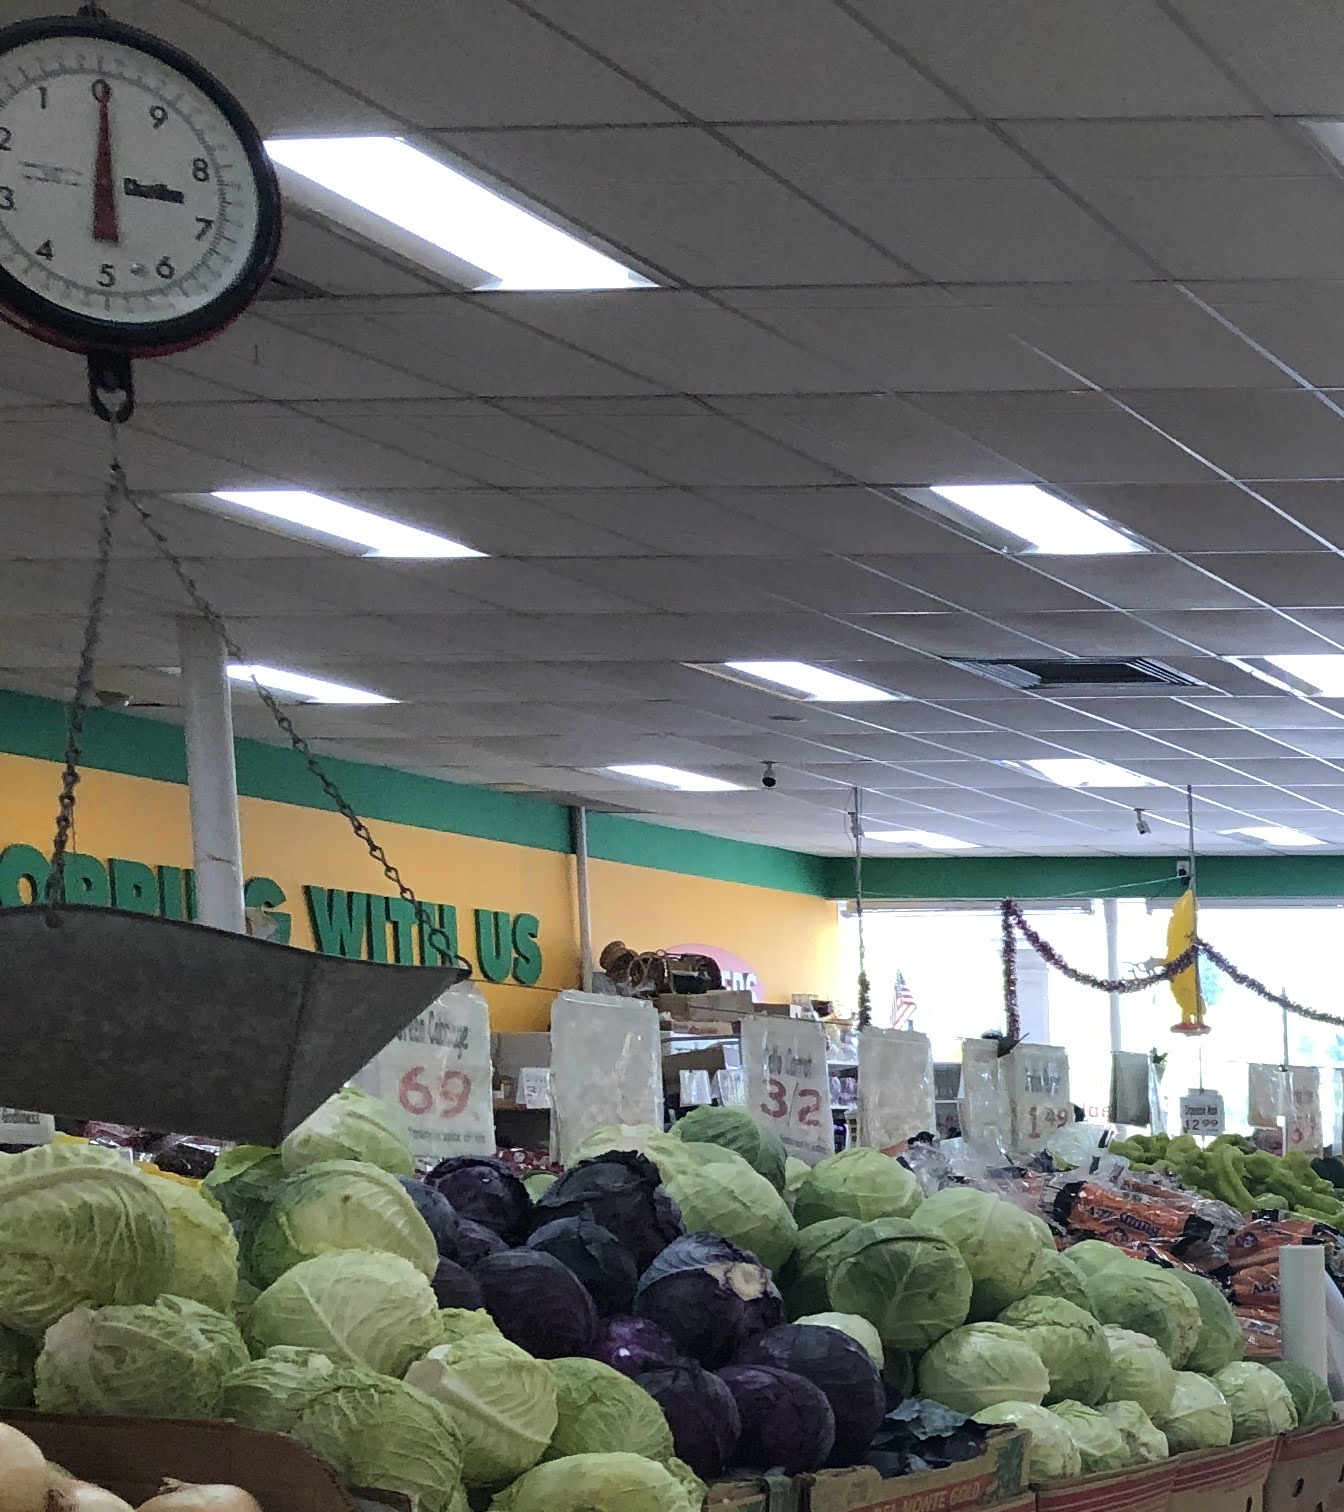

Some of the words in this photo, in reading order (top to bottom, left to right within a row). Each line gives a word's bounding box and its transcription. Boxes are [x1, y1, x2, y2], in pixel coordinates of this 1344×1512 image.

[38, 86, 47, 110] 1
[149, 105, 168, 129] 9
[192, 157, 210, 183] 8
[195, 215, 214, 241] 7
[35, 239, 54, 261] 4
[97, 263, 116, 288] 5
[156, 256, 175, 280] 6
[304, 884, 460, 966] WITH
[474, 907, 543, 985] US
[399, 1065, 473, 1120] 69
[951, 1481, 982, 1502] GOLD
